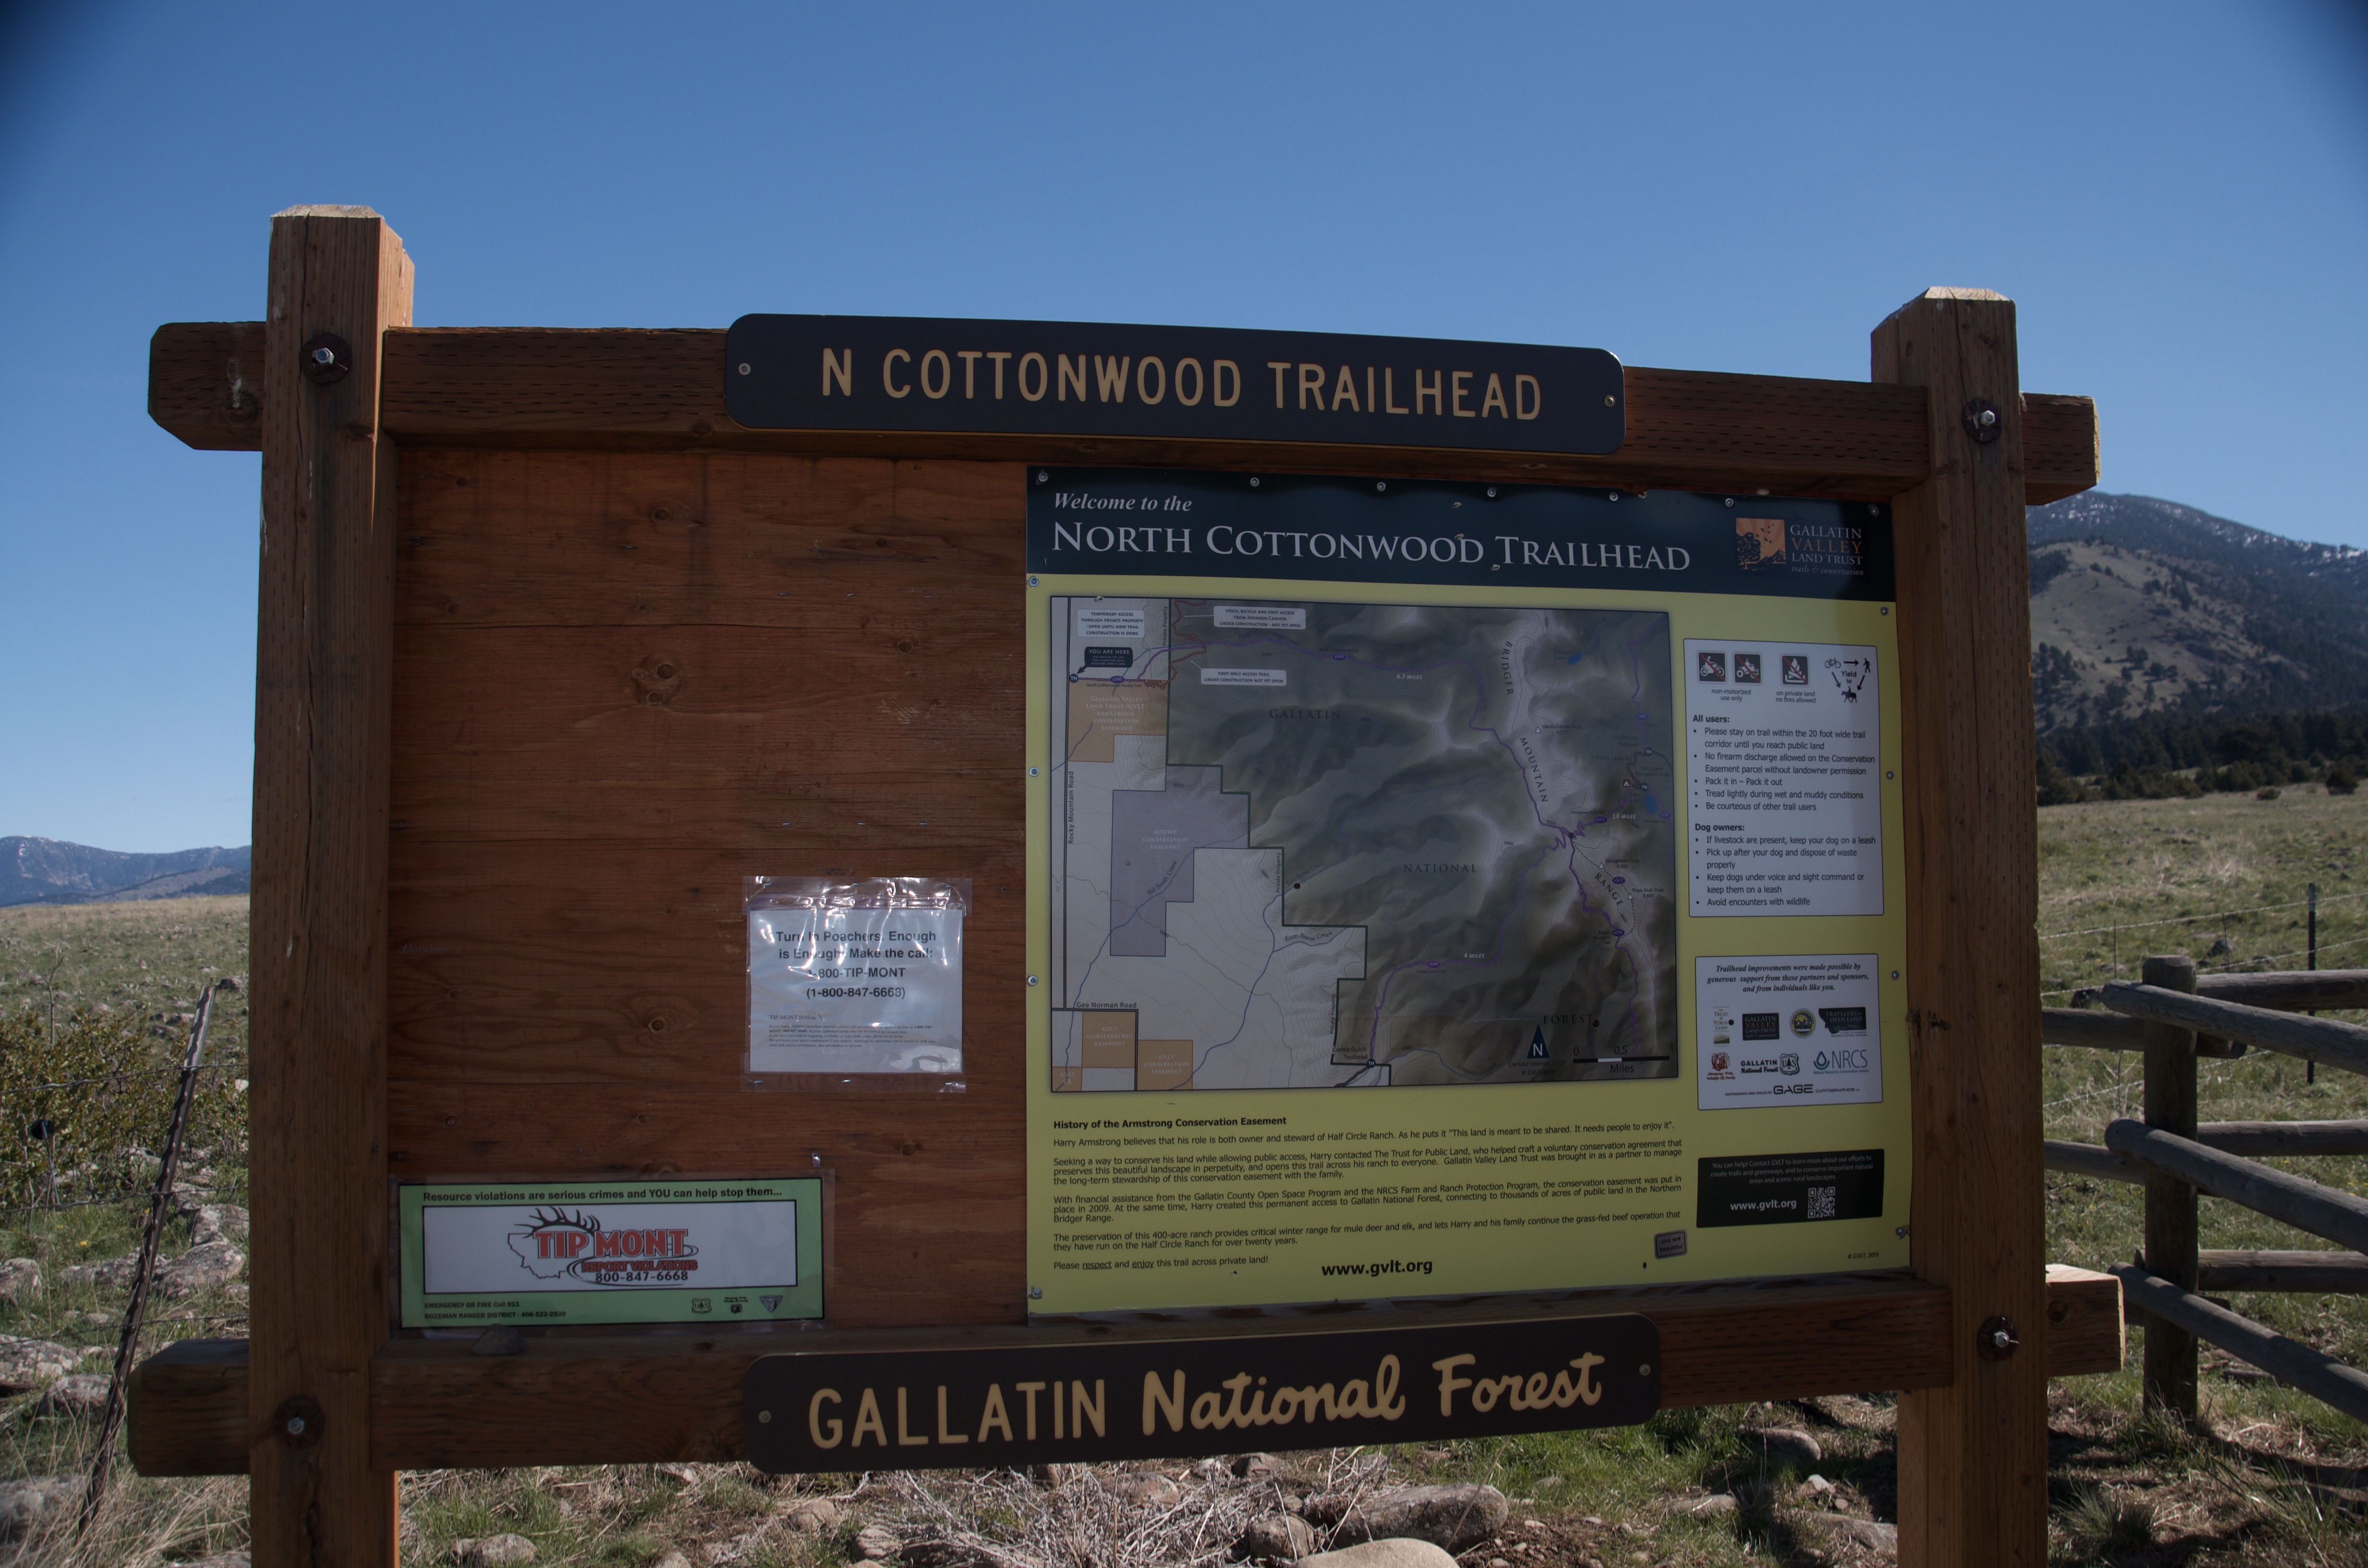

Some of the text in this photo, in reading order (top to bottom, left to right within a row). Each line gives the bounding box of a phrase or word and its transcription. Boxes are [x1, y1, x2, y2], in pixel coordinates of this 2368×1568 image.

[822, 348, 1541, 420] N COTTONWOOD TRAILHEAD
[1055, 493, 1192, 512] Welcome to the
[1790, 525, 1861, 538] GALLATIN
[1052, 521, 1690, 571] NORTH COTTONWOOD TRAILHEAD
[1792, 539, 1862, 553] VALLEY
[1792, 552, 1863, 565] LAND TRUST
[1791, 564, 1810, 573] trails
[1502, 641, 1513, 695] BRIDGER
[1269, 709, 1341, 719] GALLATIN
[1692, 714, 1703, 723] All
[1704, 727, 1727, 735] Please
[1729, 728, 1744, 737] stay
[1757, 728, 1770, 736] trail
[1772, 729, 1793, 737] within
[1809, 729, 1817, 737] 20
[1819, 730, 1833, 738] foot
[1835, 730, 1851, 738] wide
[1704, 740, 1732, 748] corridor
[1734, 740, 1750, 748] until
[1788, 741, 1808, 750] public
[1810, 742, 1825, 750] land
[1520, 737, 1548, 802] MOUNTAIN
[1705, 777, 1722, 785] Pack
[1724, 777, 1729, 785] it
[1746, 777, 1763, 785] Pack
[1764, 778, 1769, 786] it
[1695, 823, 1711, 833] Dog
[1706, 835, 1713, 844] If
[1714, 835, 1744, 844] livestock
[1759, 836, 1788, 845] present,
[1789, 836, 1807, 845] keep
[1825, 836, 1839, 846] dog
[1858, 836, 1876, 844] leash
[1404, 863, 1478, 874] NATIONAL
[1594, 873, 1624, 907] RANGE
[776, 931, 804, 942] Turn
[824, 931, 885, 942] Poachers.
[889, 931, 937, 943] Enough
[779, 949, 789, 959] is
[850, 948, 881, 958] Make
[885, 948, 904, 958] the
[807, 967, 906, 979] 1-800-TIP-MONT
[1748, 965, 1792, 973] improvements
[1826, 963, 1852, 972] possible
[1853, 963, 1861, 971] by
[806, 987, 906, 1000] (1-800-847-6668)
[1543, 1014, 1594, 1025] FOREST
[1533, 1043, 1542, 1056] N
[1614, 1046, 1628, 1054] 0.5
[1831, 1049, 1868, 1069] NRCS
[1610, 1064, 1634, 1073] Miles
[1773, 1084, 1814, 1095] GAGE
[1054, 1117, 1287, 1130] History of the Armstrong Conservation Easement
[423, 1192, 472, 1201] Resource
[475, 1191, 526, 1200] violations
[548, 1190, 586, 1200] serious
[589, 1189, 624, 1199] crimes
[627, 1189, 646, 1199] and
[649, 1188, 670, 1198] YOU
[695, 1188, 718, 1199] help
[720, 1188, 743, 1199] stop
[745, 1188, 782, 1196] them...
[1730, 1199, 1797, 1211] www.gvlt.org
[533, 1229, 689, 1259] TIP MONT
[581, 1260, 698, 1273] REPORT VIOLATIONS
[1054, 1262, 1080, 1270] Please
[1082, 1261, 1112, 1270] respect
[1114, 1260, 1130, 1268] and
[1132, 1260, 1154, 1269] enjoy
[1157, 1259, 1172, 1267] this
[1173, 1258, 1189, 1266] trail
[1219, 1257, 1246, 1266] private
[1249, 1255, 1268, 1264] land!
[1321, 1260, 1432, 1278] www.gvlt.org
[595, 1271, 689, 1282] 800-847-6668
[809, 1352, 1605, 1449] GALLATIN National Forest
